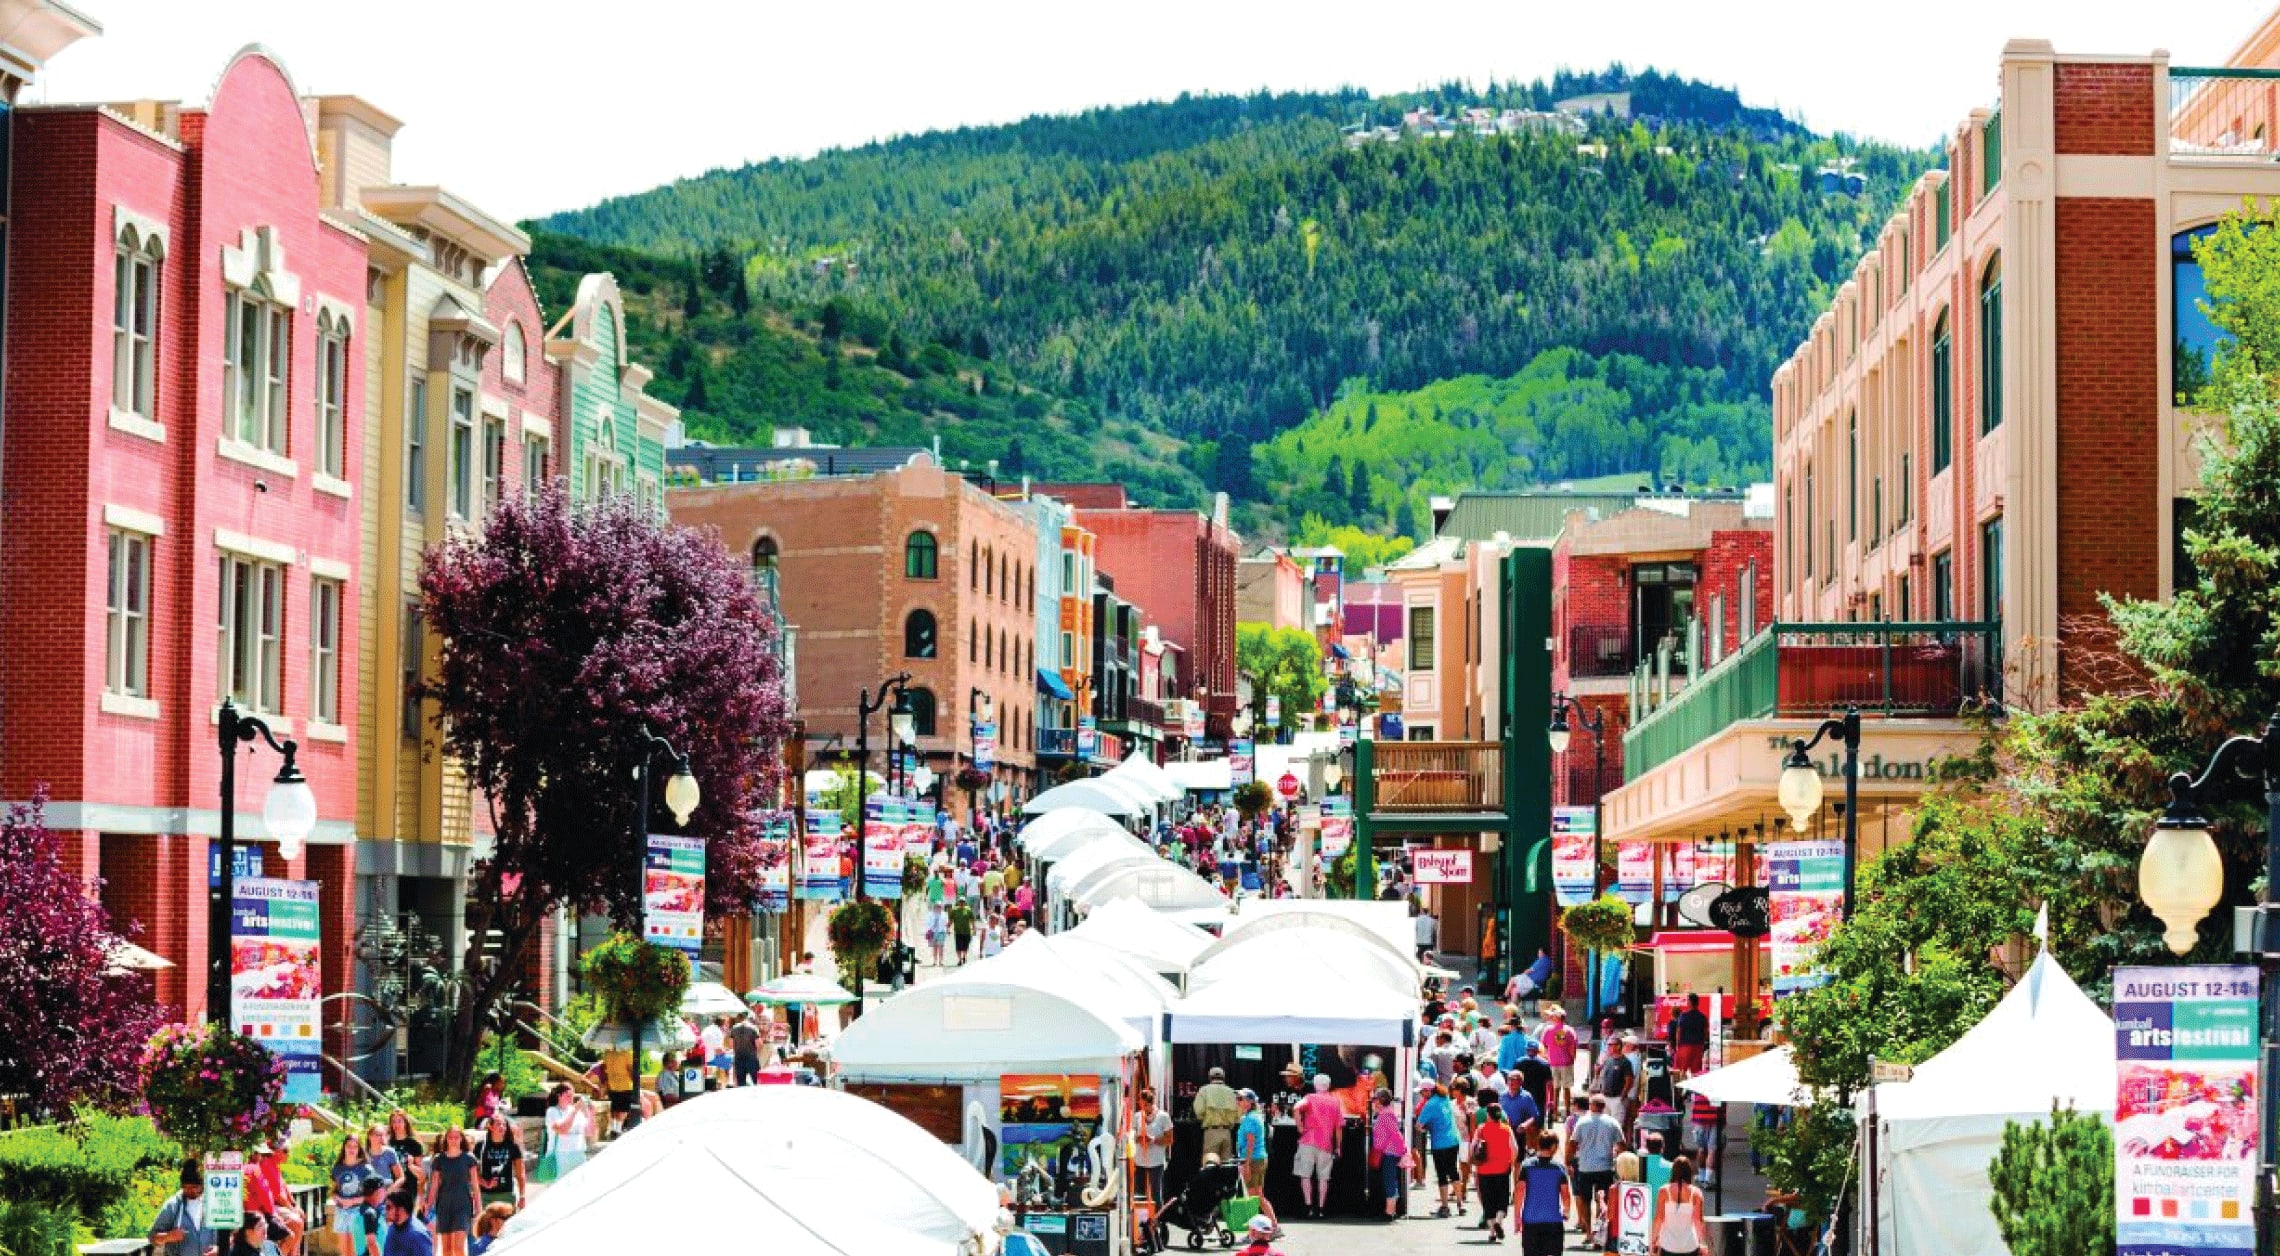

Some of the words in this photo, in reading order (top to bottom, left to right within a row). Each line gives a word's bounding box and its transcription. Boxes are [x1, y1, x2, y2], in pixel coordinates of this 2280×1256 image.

[239, 885, 283, 898] AUGUST
[2124, 981, 2198, 998] AUGUST
[2205, 981, 2250, 997] 12-14
[2133, 1163, 2142, 1176] A
[2143, 1164, 2214, 1178] FUNDRAISER
[2217, 1165, 2240, 1178] FOR
